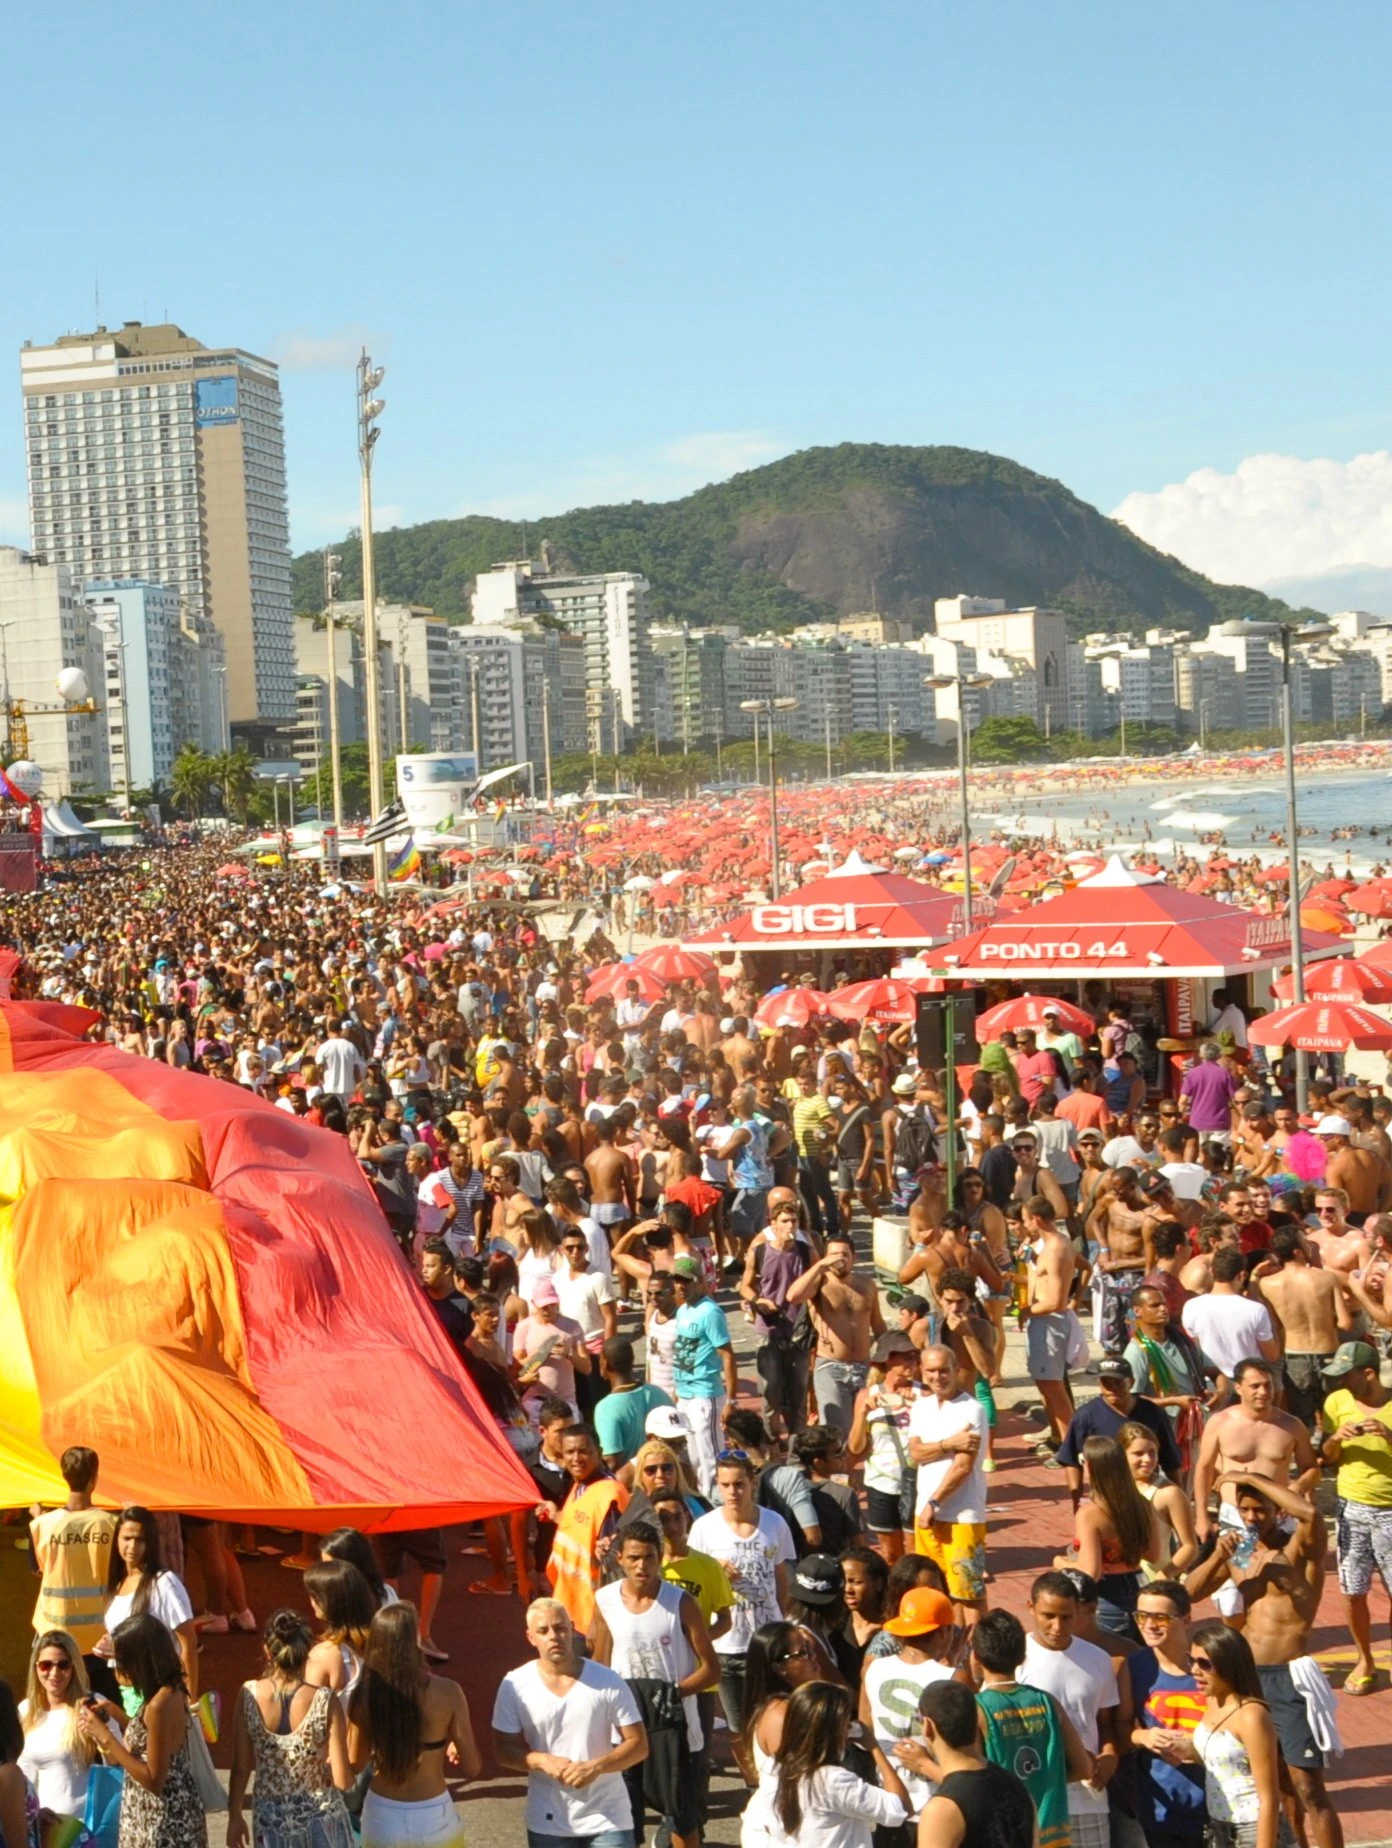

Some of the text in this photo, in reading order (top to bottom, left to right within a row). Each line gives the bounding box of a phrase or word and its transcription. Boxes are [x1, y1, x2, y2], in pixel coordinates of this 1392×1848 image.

[402, 765, 414, 782] 5
[751, 902, 857, 934] GIGI
[979, 941, 1128, 960] PONTO 44
[49, 1532, 110, 1545] ALFASEG
